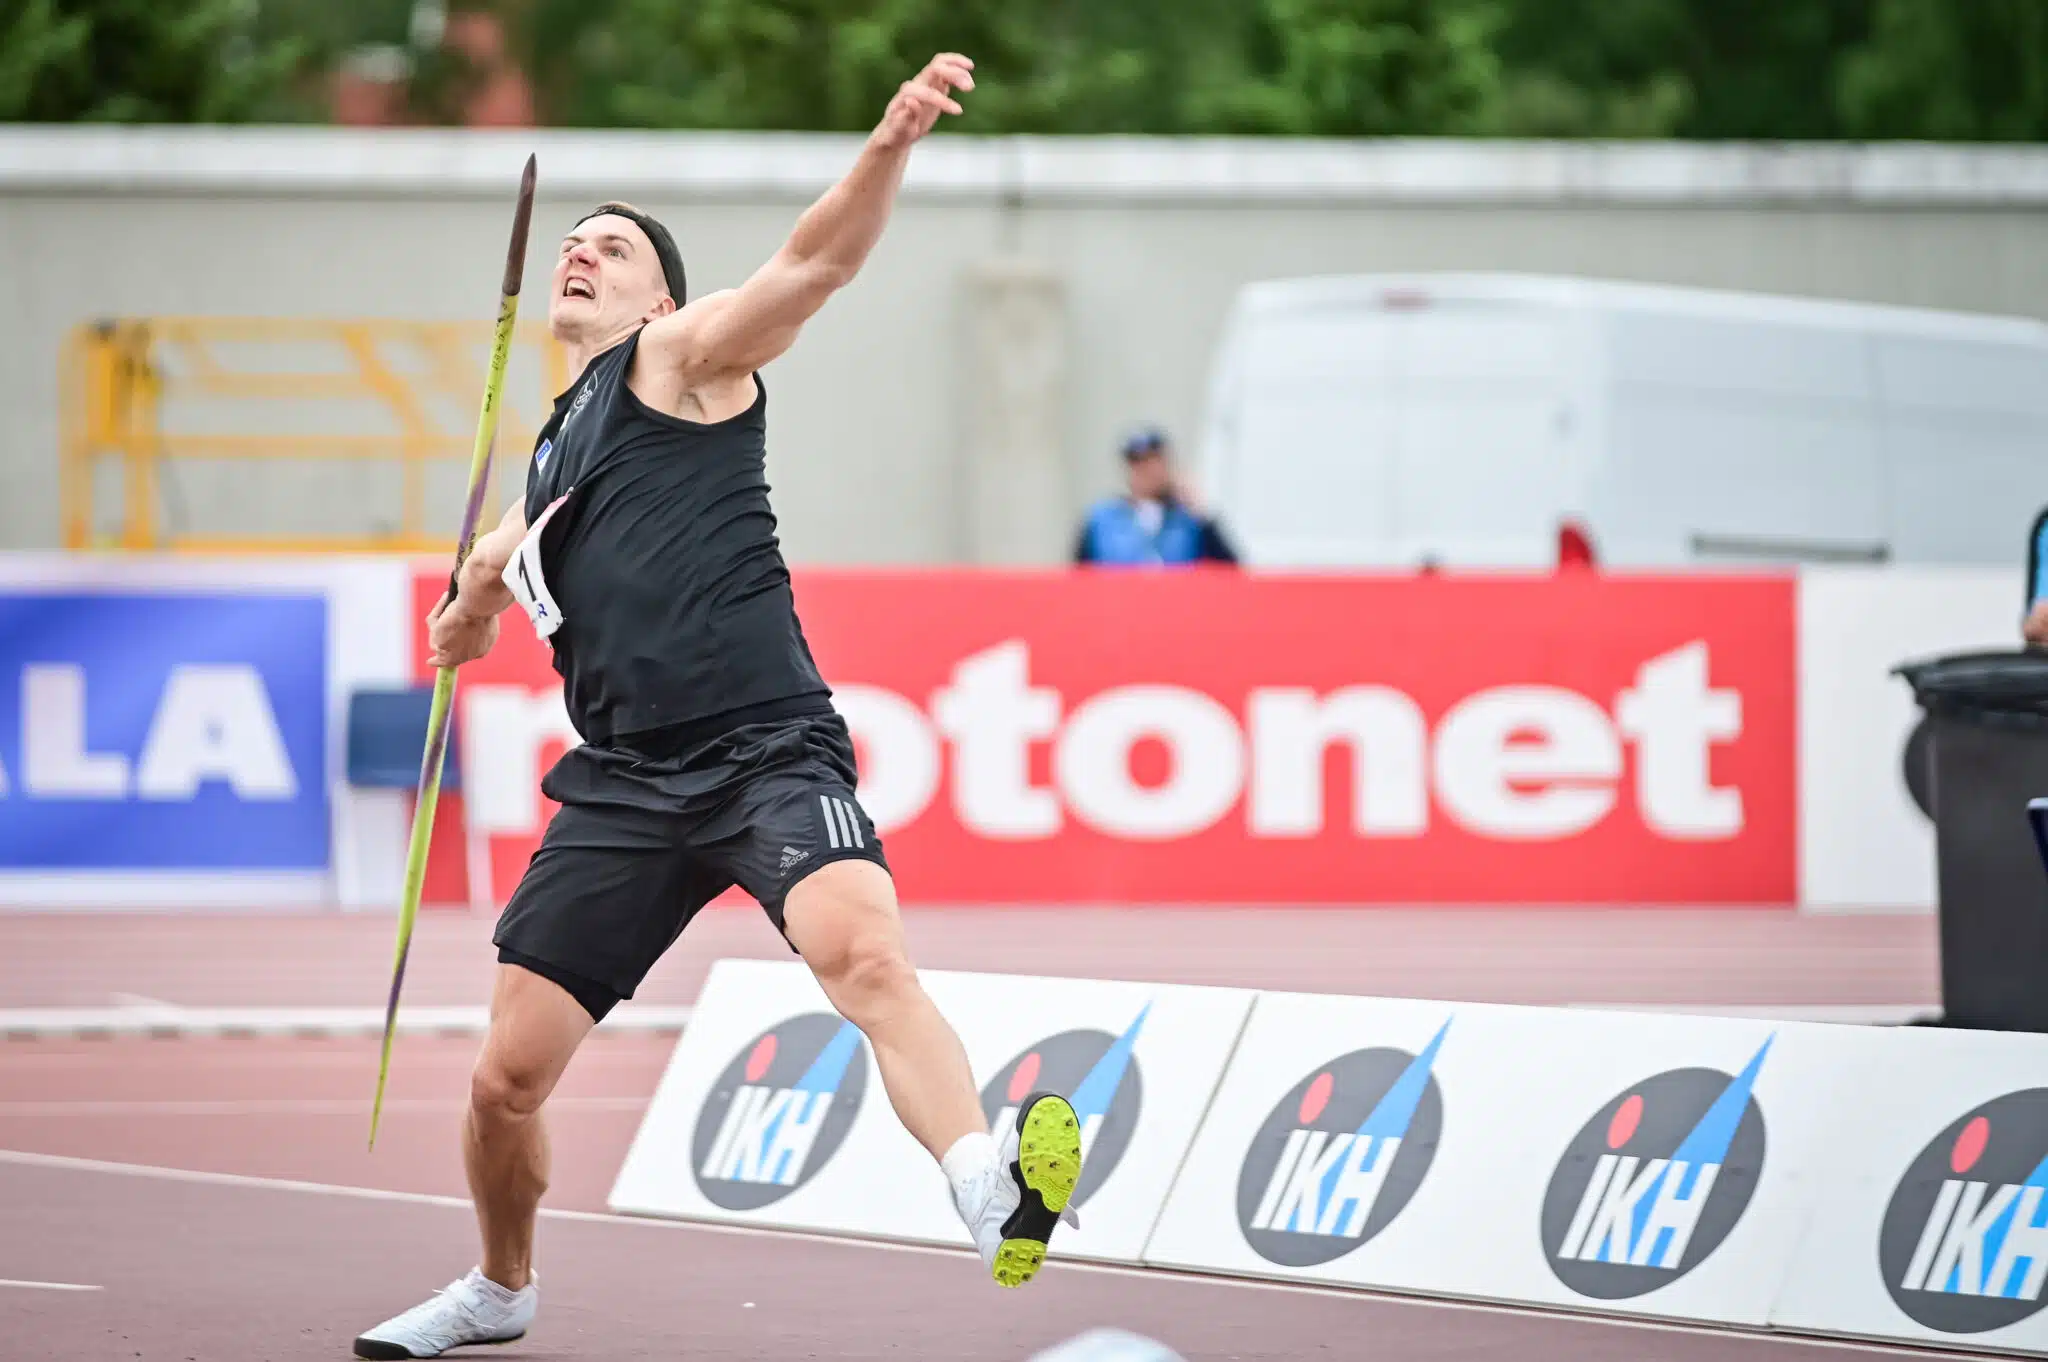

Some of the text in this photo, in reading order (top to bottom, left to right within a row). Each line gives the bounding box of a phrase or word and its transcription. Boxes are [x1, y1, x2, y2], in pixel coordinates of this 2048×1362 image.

[0, 662, 298, 799] LA
[701, 1085, 836, 1186] IKH
[1250, 1129, 1402, 1239] IKH
[1557, 1154, 1722, 1269] IKH
[1900, 1179, 2048, 1301] IKH
